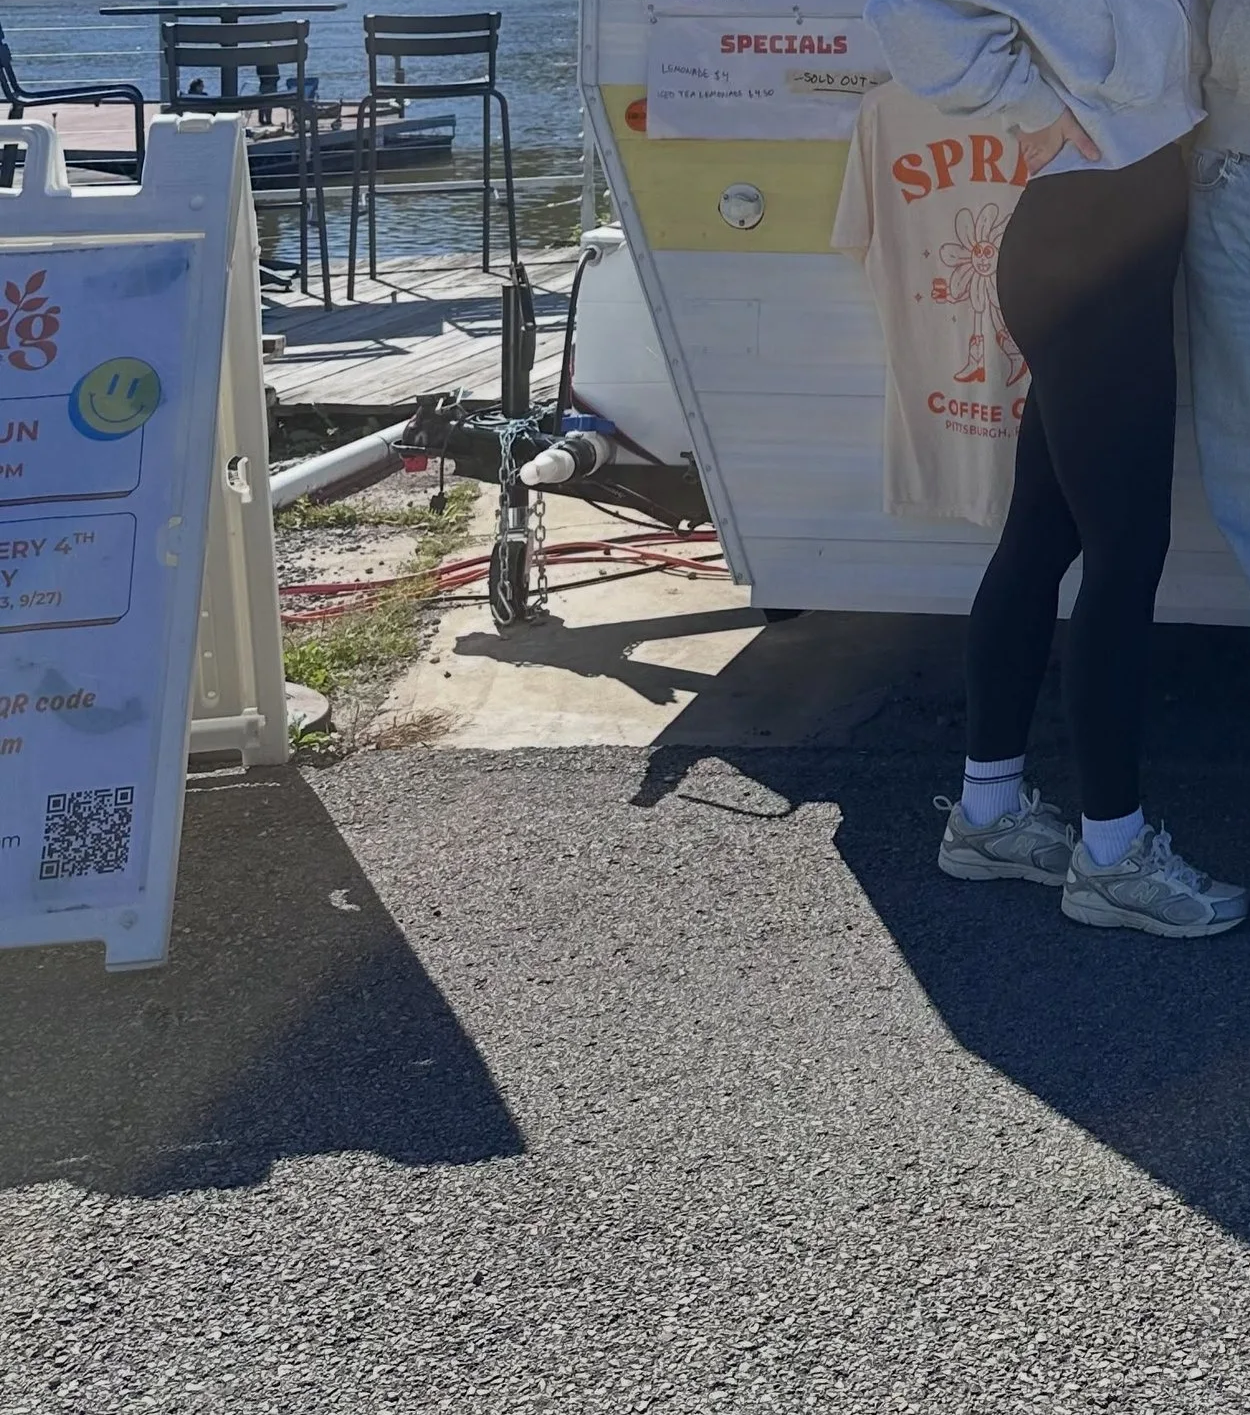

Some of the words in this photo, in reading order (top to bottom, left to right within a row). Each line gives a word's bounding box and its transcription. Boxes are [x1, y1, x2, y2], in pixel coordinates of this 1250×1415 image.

[720, 35, 848, 55] SPECIALS
[661, 63, 709, 79] LEMONADE
[714, 70, 730, 82] $4
[678, 90, 696, 99] TEA
[927, 391, 1004, 423] COFFEE
[1011, 397, 1026, 420] C
[945, 420, 1011, 439] PITTSBURGH,
[19, 590, 62, 608] 9/27)
[35, 688, 97, 713] code
